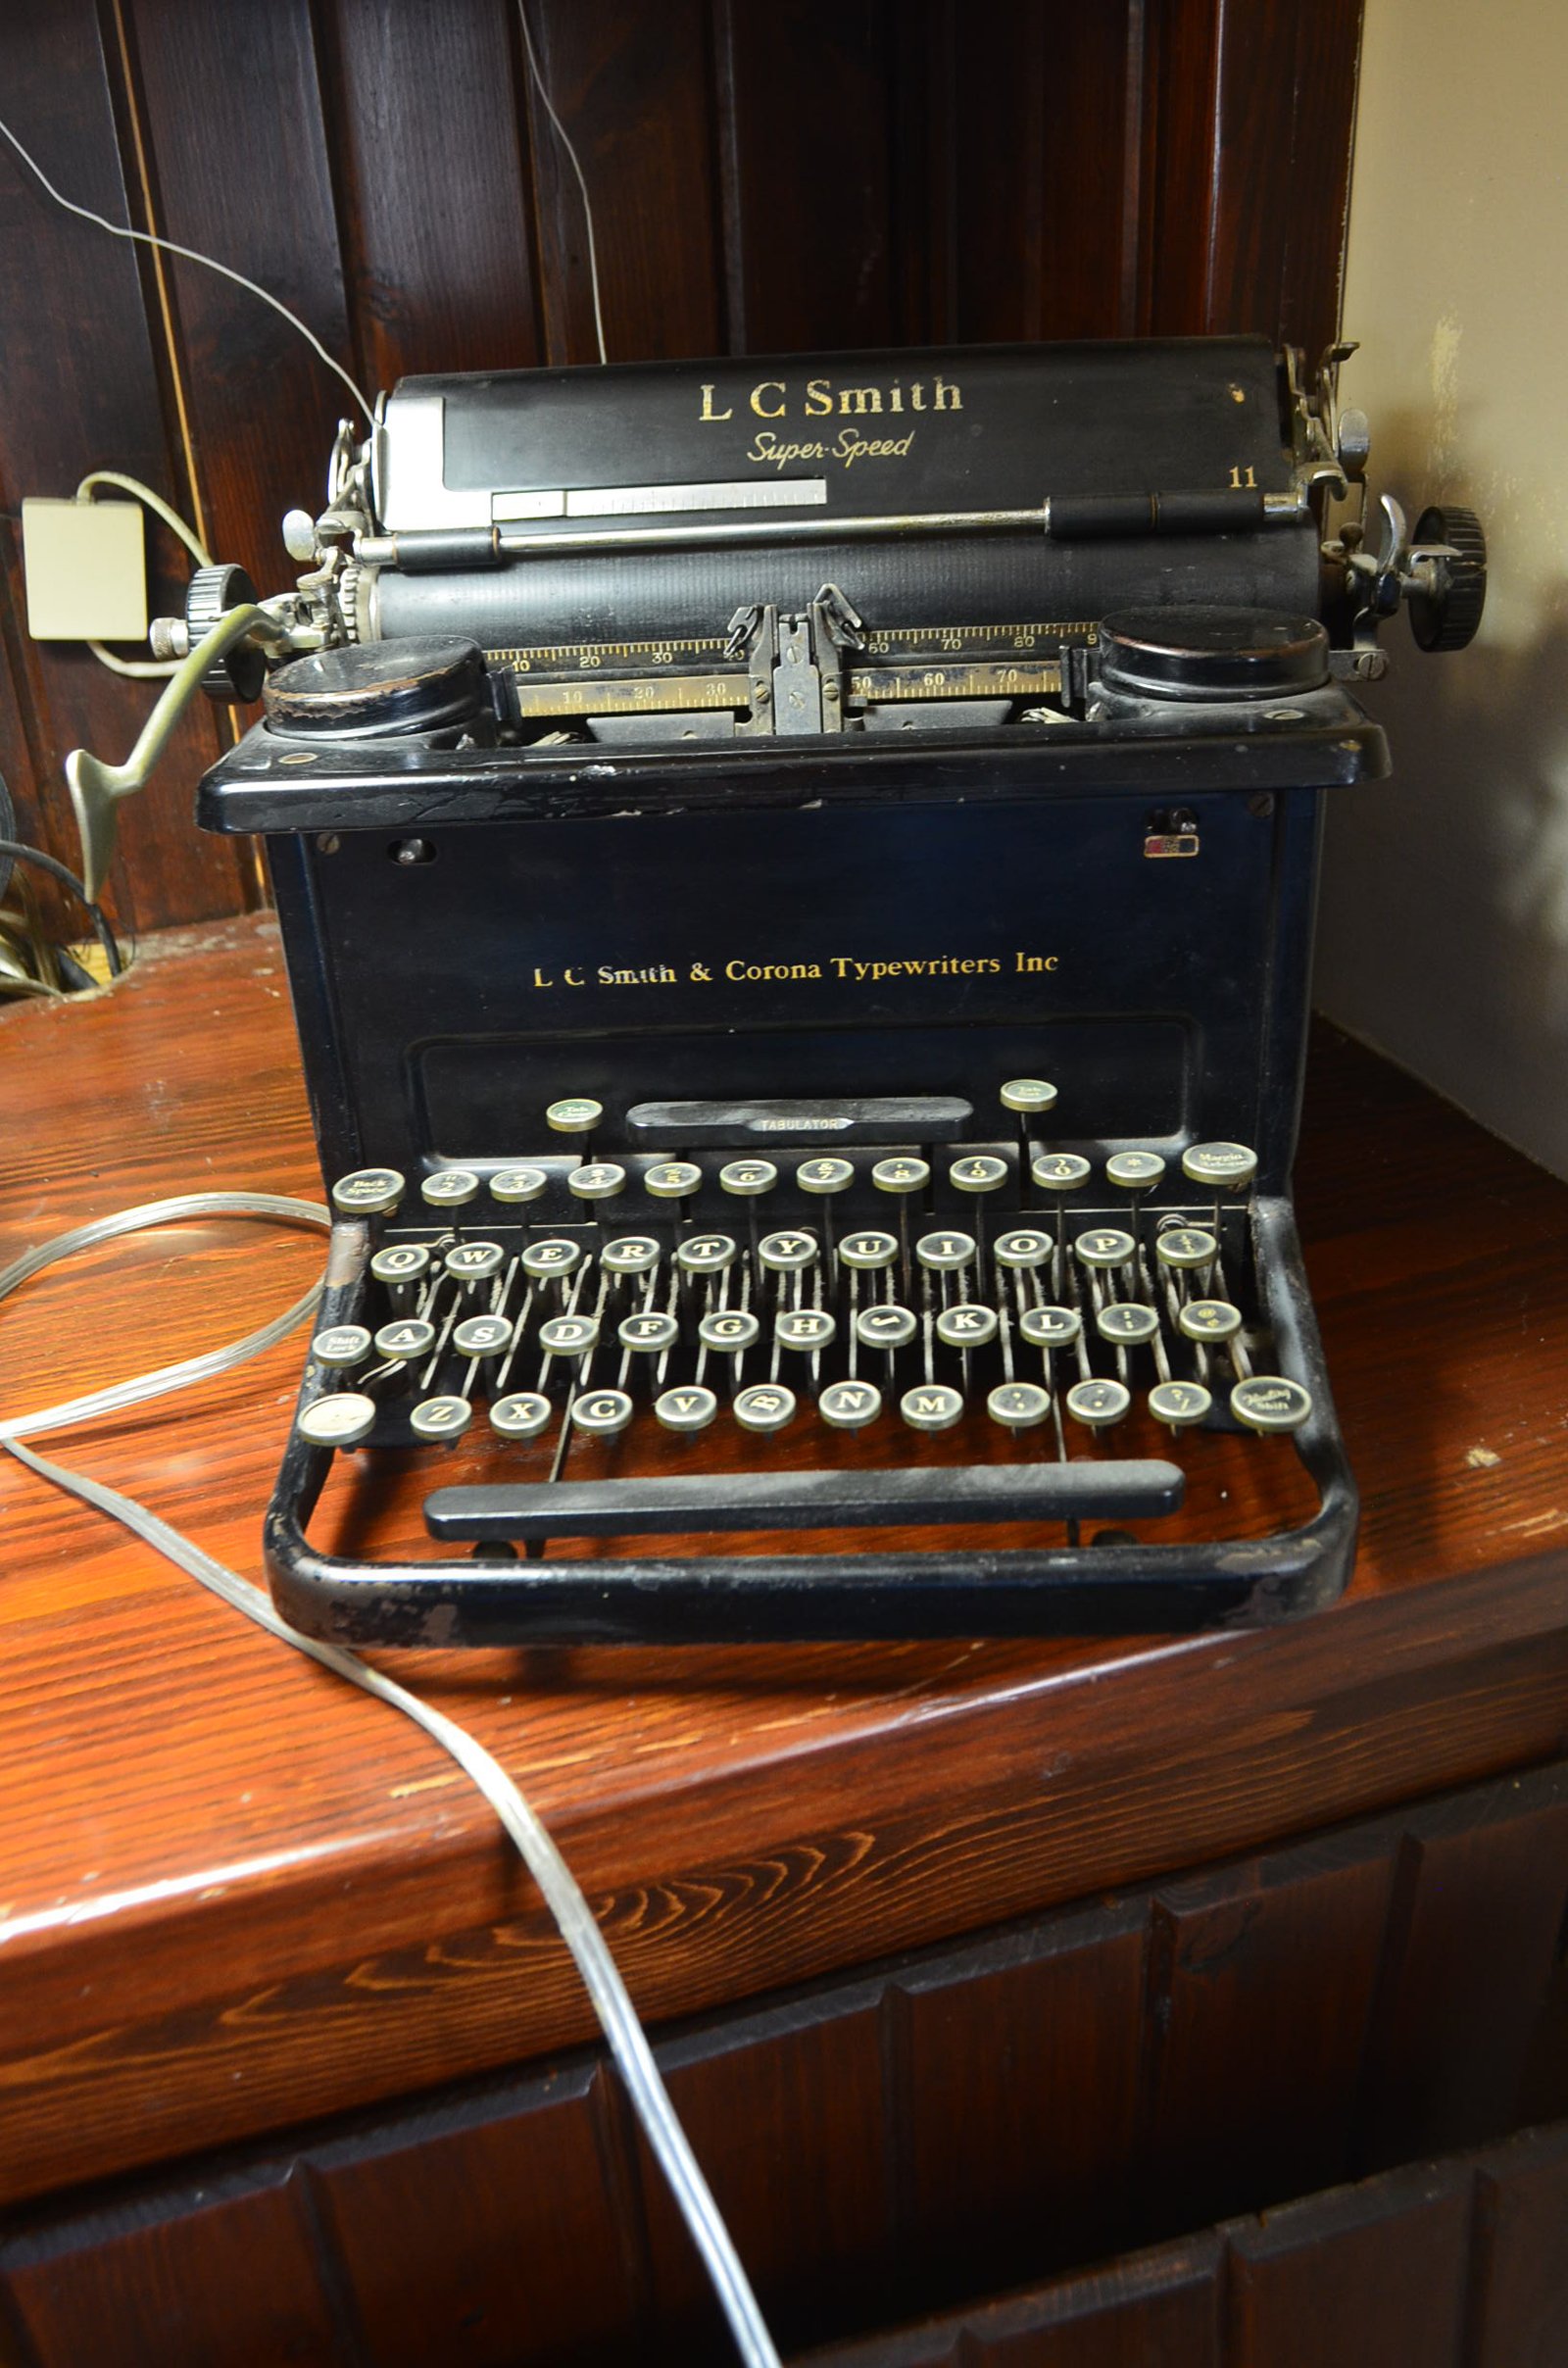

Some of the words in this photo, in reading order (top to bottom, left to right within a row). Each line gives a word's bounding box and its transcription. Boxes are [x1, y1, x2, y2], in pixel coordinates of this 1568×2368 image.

[699, 384, 733, 421] L
[750, 381, 786, 418] C
[805, 375, 963, 416] Smith
[1229, 466, 1257, 488] 11
[512, 660, 530, 672] 10
[579, 656, 601, 668] 20
[652, 652, 673, 665] 30
[868, 642, 890, 655] 60
[941, 638, 962, 651] 70
[1014, 635, 1036, 649] 80
[563, 690, 583, 704] 10
[634, 686, 655, 699] 20
[706, 682, 726, 697] 30
[851, 675, 872, 689] 50
[923, 672, 945, 686] 60
[997, 669, 1018, 683] 70
[533, 967, 554, 987] L
[564, 966, 585, 986] C
[597, 964, 677, 985] Smith
[690, 962, 713, 981] &
[725, 960, 822, 981] Corona
[830, 955, 1002, 981] Typewriters
[1015, 951, 1059, 973] Inc
[760, 1118, 838, 1130] TABULATOR
[739, 1171, 756, 1182] 6
[894, 1168, 911, 1179] 8
[619, 1245, 645, 1258] R
[692, 1242, 720, 1258] T
[777, 1240, 803, 1255] Y
[856, 1240, 882, 1255] U
[940, 1240, 956, 1255] I
[1009, 1238, 1039, 1253] O
[1094, 1237, 1118, 1253] P
[387, 1252, 416, 1268] Q
[461, 1250, 493, 1263] W
[538, 1247, 564, 1262] E
[637, 1320, 663, 1336] F
[713, 1318, 744, 1335] G
[791, 1317, 821, 1335] H
[954, 1312, 981, 1330] K
[1039, 1313, 1065, 1330] L
[388, 1327, 416, 1344] A
[470, 1326, 496, 1344] S
[554, 1324, 583, 1341] D
[589, 1399, 616, 1418] C
[672, 1396, 700, 1413] V
[749, 1394, 782, 1412] B
[836, 1391, 866, 1409] N
[915, 1395, 947, 1413] M
[427, 1405, 456, 1422] Z
[509, 1403, 535, 1420] X
